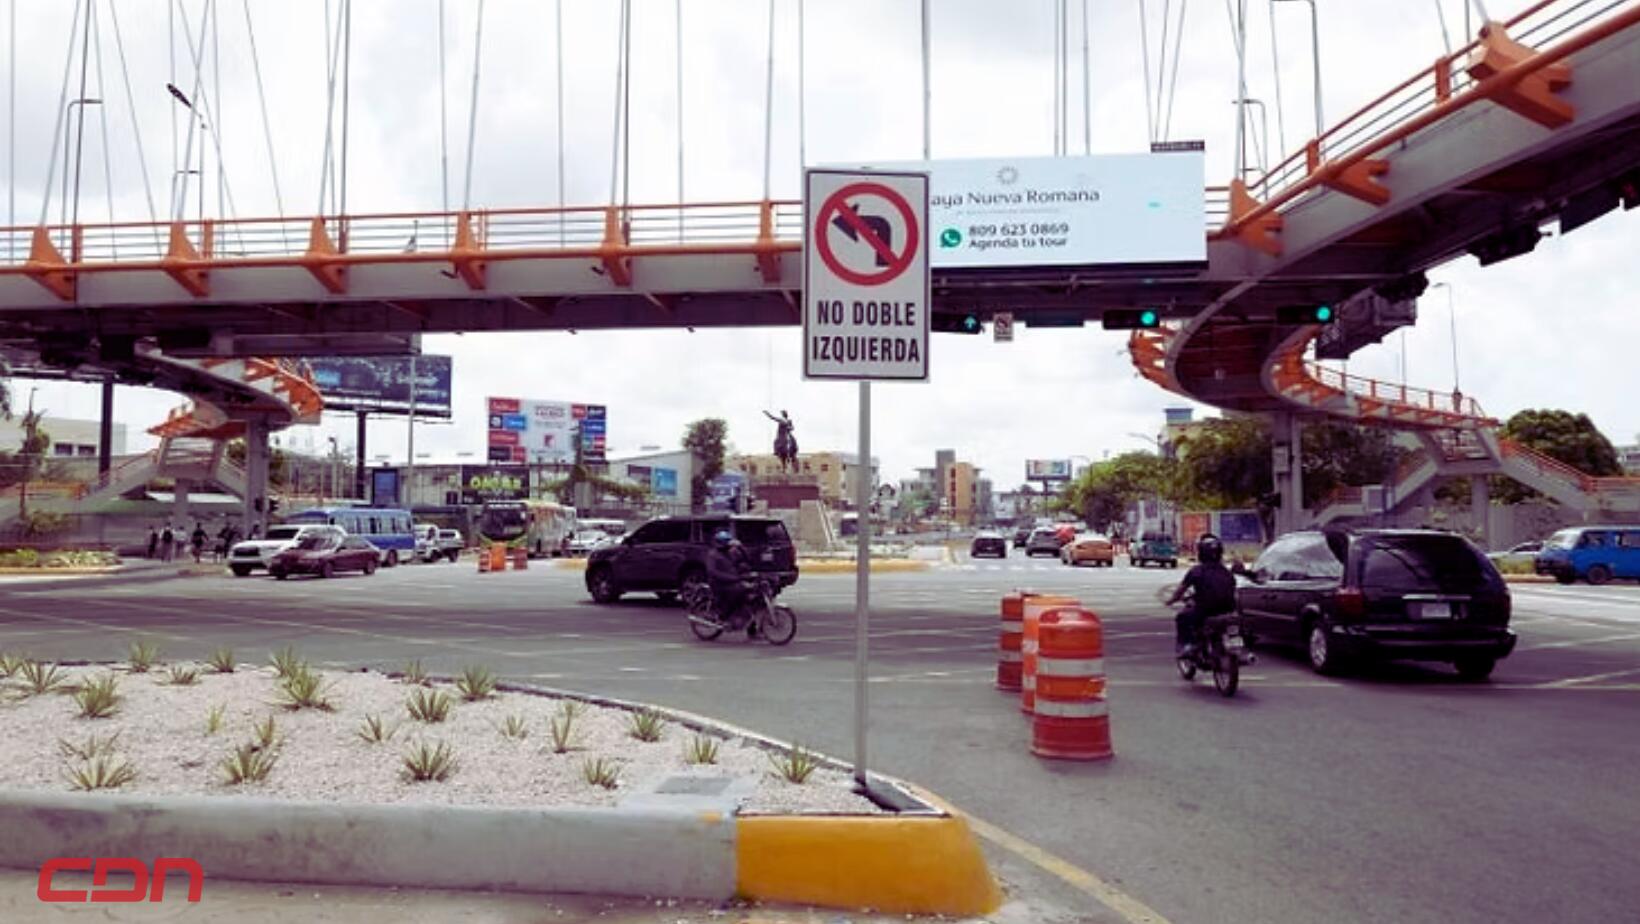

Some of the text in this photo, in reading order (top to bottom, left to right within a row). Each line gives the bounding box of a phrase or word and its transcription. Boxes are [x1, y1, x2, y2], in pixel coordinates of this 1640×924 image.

[931, 188, 1100, 209] aya Nueva Romana
[968, 221, 1069, 237] 809 623 0869
[968, 236, 1067, 250] Agenda tu tour
[817, 300, 915, 326] NO DOBLE
[813, 336, 920, 364] IZQUIERDA
